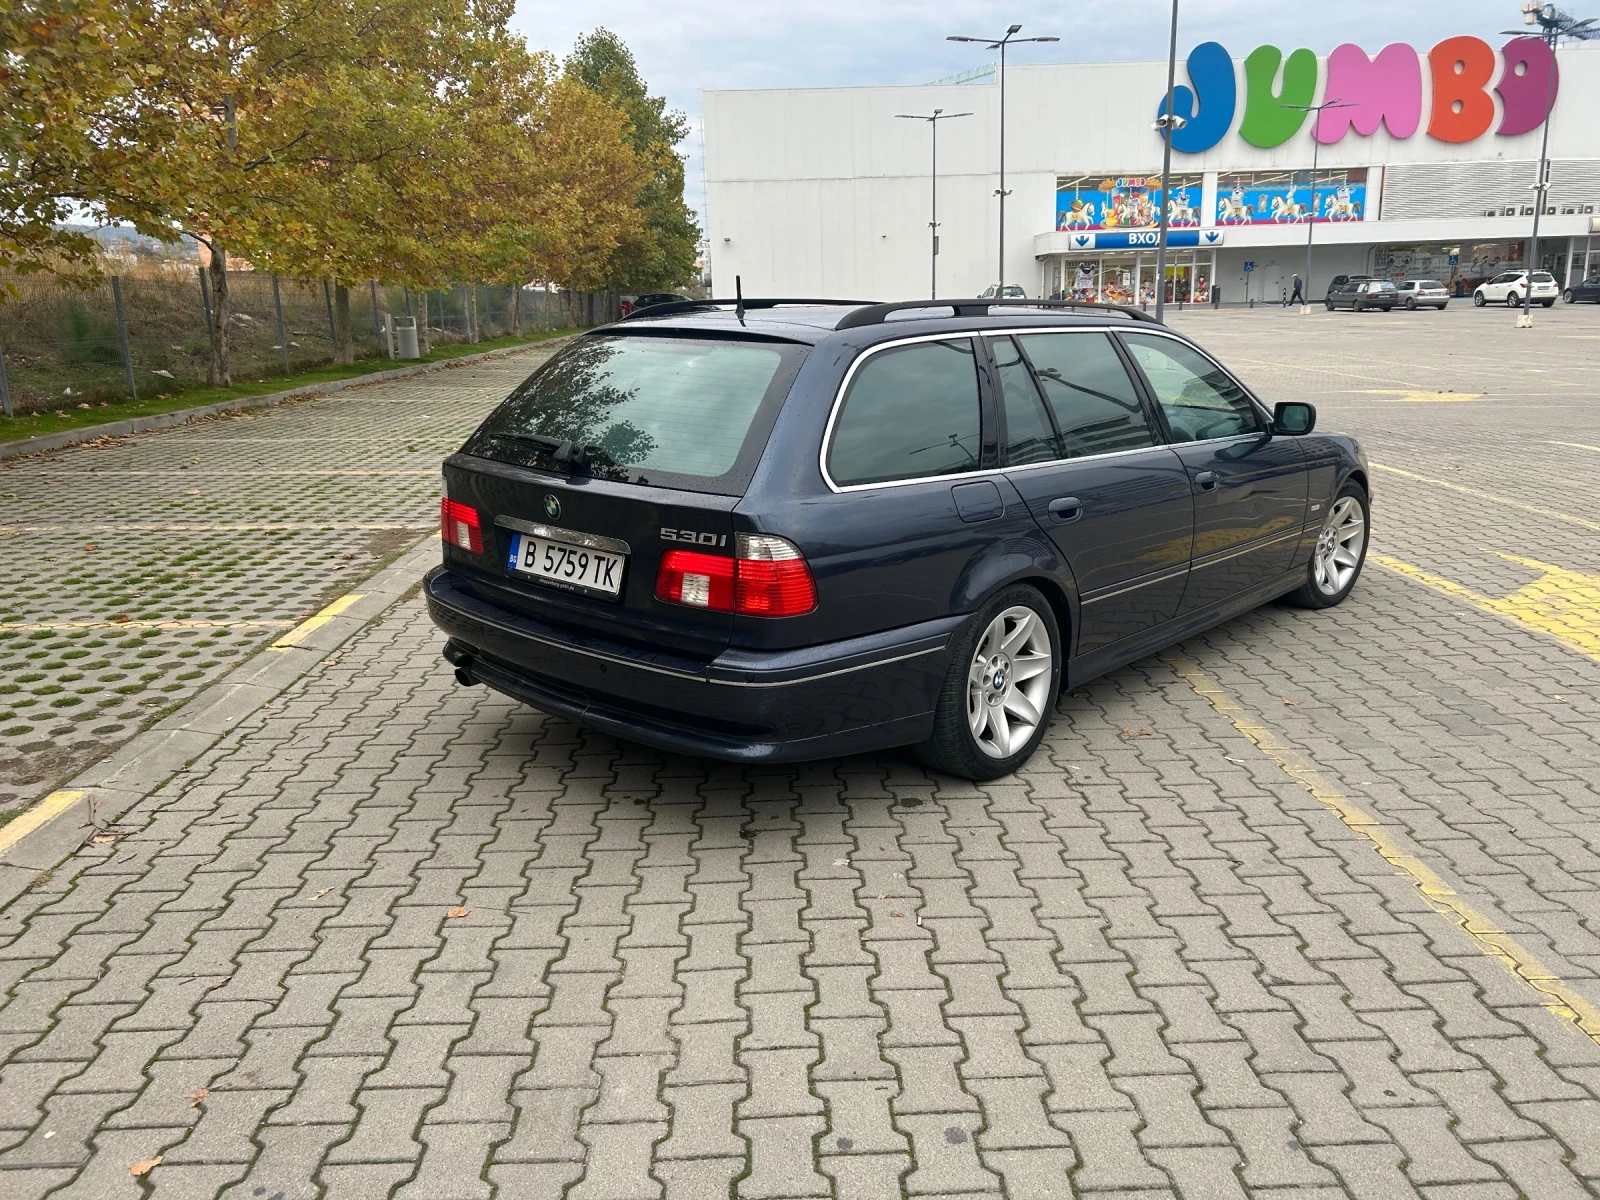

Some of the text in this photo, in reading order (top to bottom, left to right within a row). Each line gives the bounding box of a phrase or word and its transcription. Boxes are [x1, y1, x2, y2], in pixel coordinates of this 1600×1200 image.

[1157, 35, 1560, 153] JUMBO
[1116, 177, 1146, 187] JUMBO
[523, 540, 618, 588] B 5759 TK
